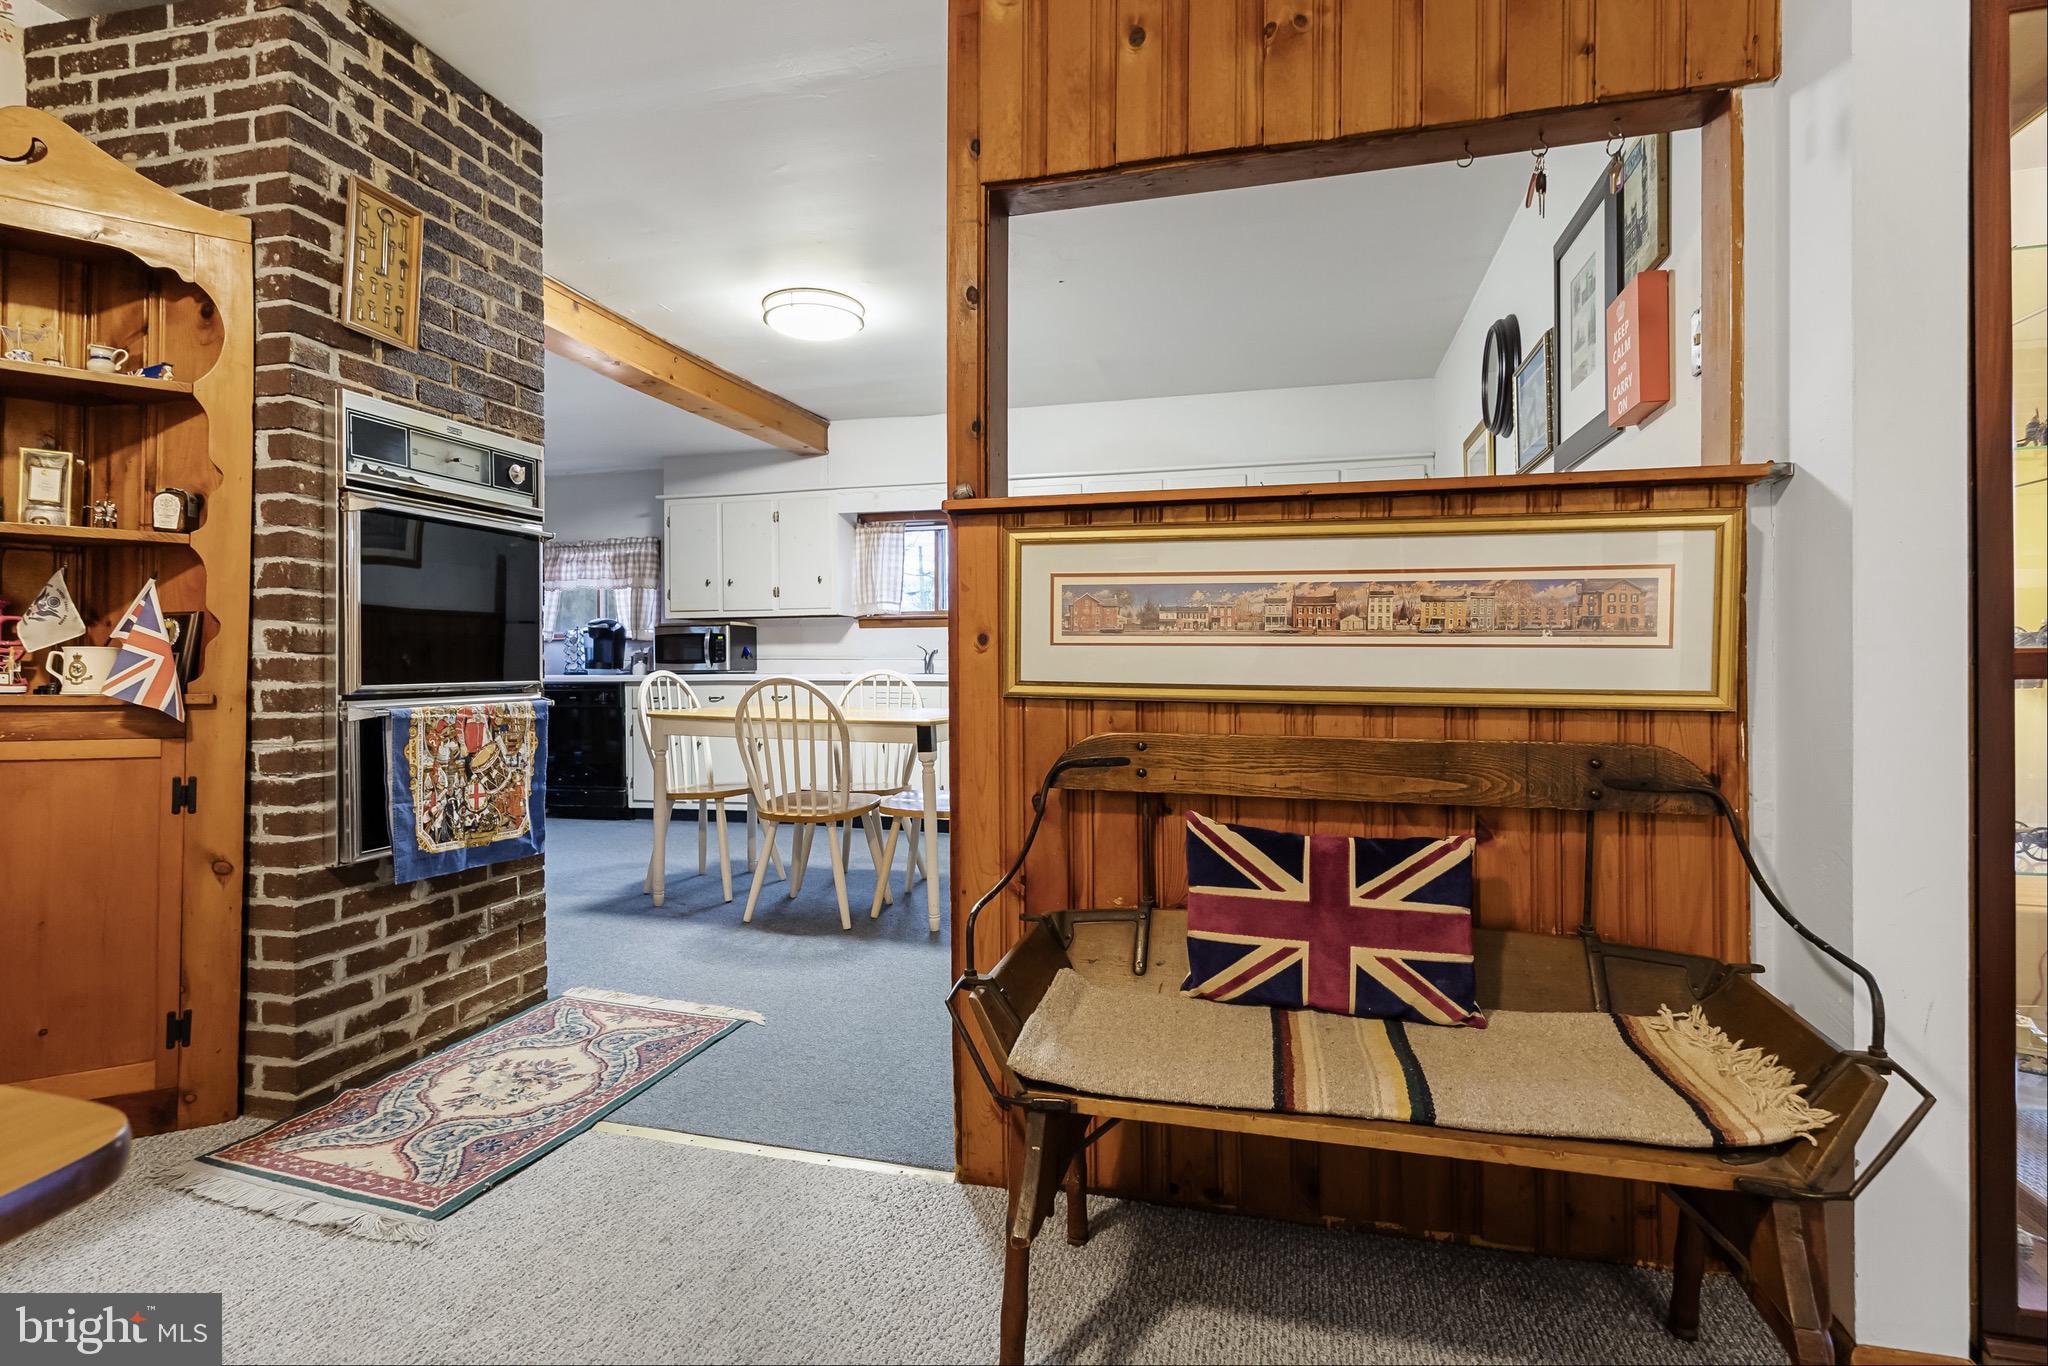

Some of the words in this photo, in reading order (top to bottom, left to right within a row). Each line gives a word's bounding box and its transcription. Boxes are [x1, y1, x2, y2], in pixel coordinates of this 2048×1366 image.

[1613, 319, 1629, 346] KEEP
[1613, 336, 1631, 365] CALM
[1617, 361, 1627, 376] AND
[1612, 372, 1633, 401] CARRY
[1617, 396, 1628, 414] ON
